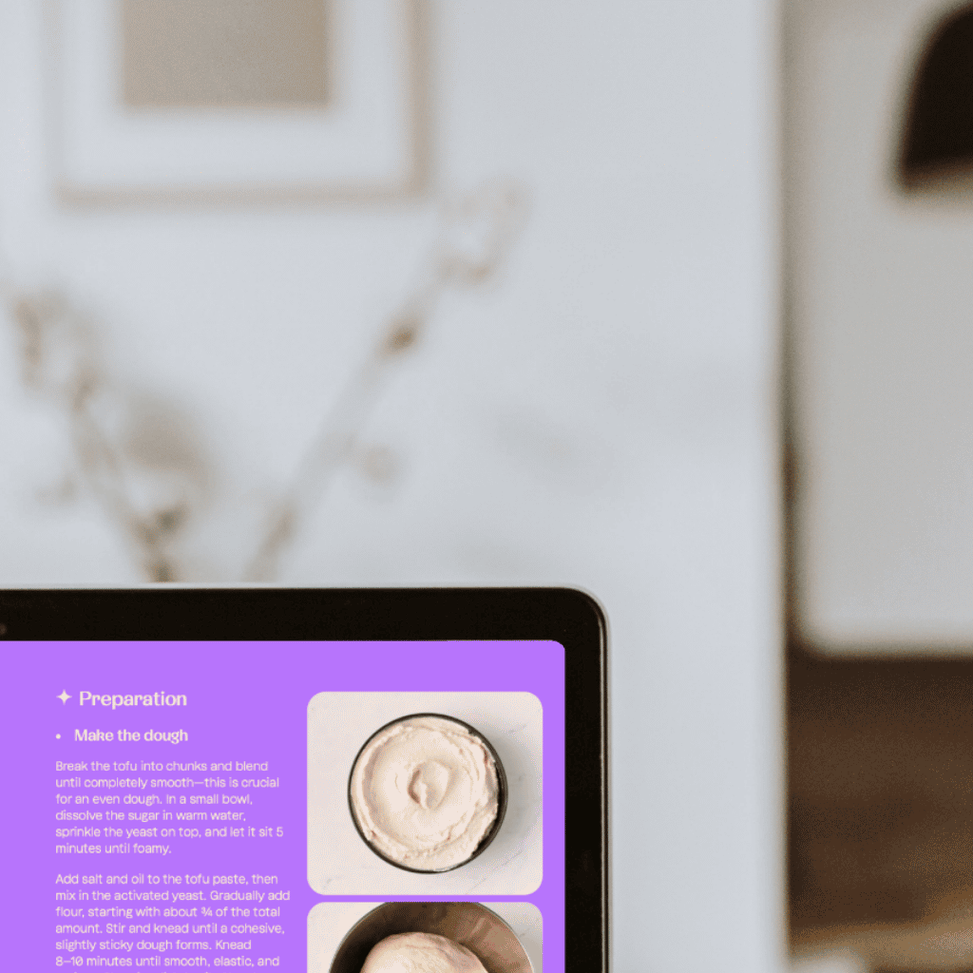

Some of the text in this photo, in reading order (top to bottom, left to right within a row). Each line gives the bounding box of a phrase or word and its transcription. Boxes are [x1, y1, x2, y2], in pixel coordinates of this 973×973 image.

[79, 691, 188, 710] Preparation
[74, 729, 189, 744] Make the dough
[55, 760, 269, 771] Break the tofu into chunks and blend
[55, 777, 81, 788] until
[83, 777, 149, 789] completely
[228, 777, 239, 788] is
[240, 777, 280, 788] crucial
[55, 809, 246, 822] dissolve the sugar in warm water,
[55, 843, 172, 855] minutes until foamy.
[55, 939, 252, 952] slightly sticky dough forms. Knead
[86, 956, 133, 966] minutes
[135, 955, 161, 966] until
[163, 956, 211, 967] smooth,
[213, 956, 255, 967] elastic,
[257, 956, 280, 966] and
